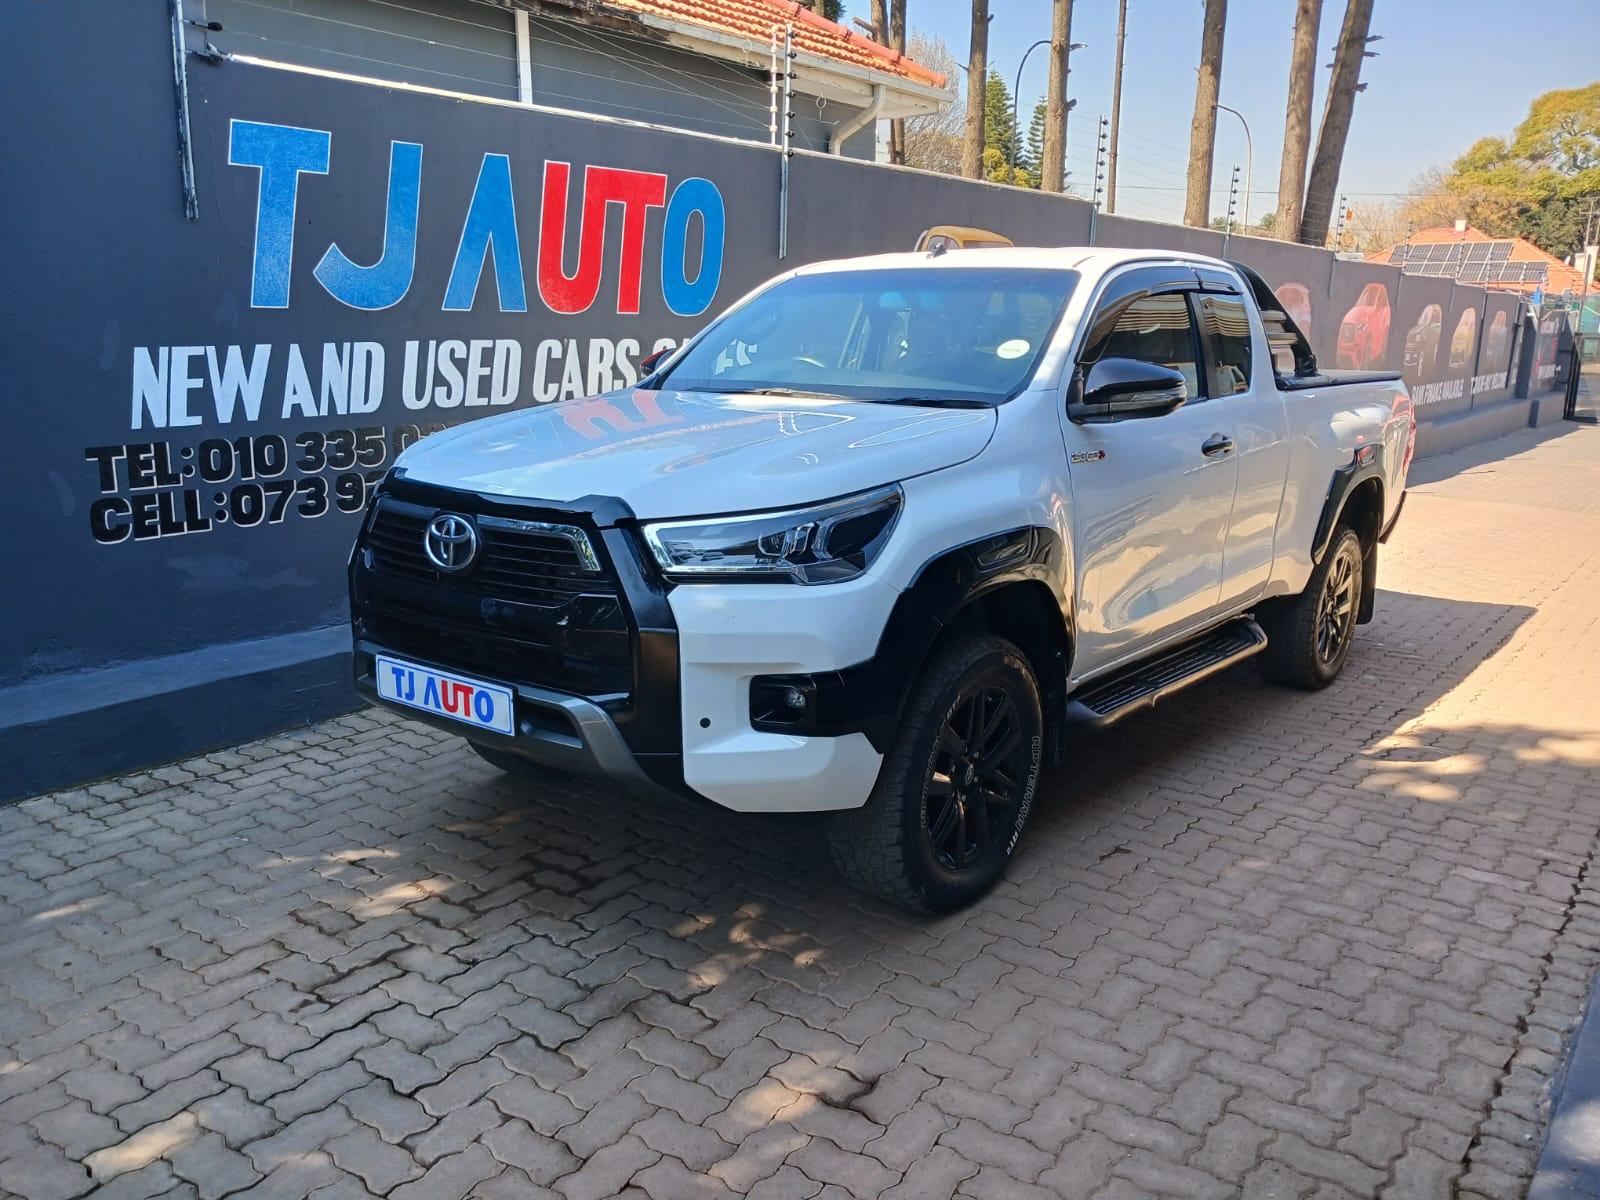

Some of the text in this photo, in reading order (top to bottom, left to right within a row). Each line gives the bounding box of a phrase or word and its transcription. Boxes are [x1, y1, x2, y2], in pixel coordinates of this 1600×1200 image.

[228, 119, 725, 317] TJ AUTO
[130, 343, 272, 430] NEW
[281, 341, 385, 420] AND
[402, 338, 522, 410] USED
[532, 337, 640, 403] CARS
[296, 426, 387, 474] 335
[391, 666, 494, 723] TJ AUTO
